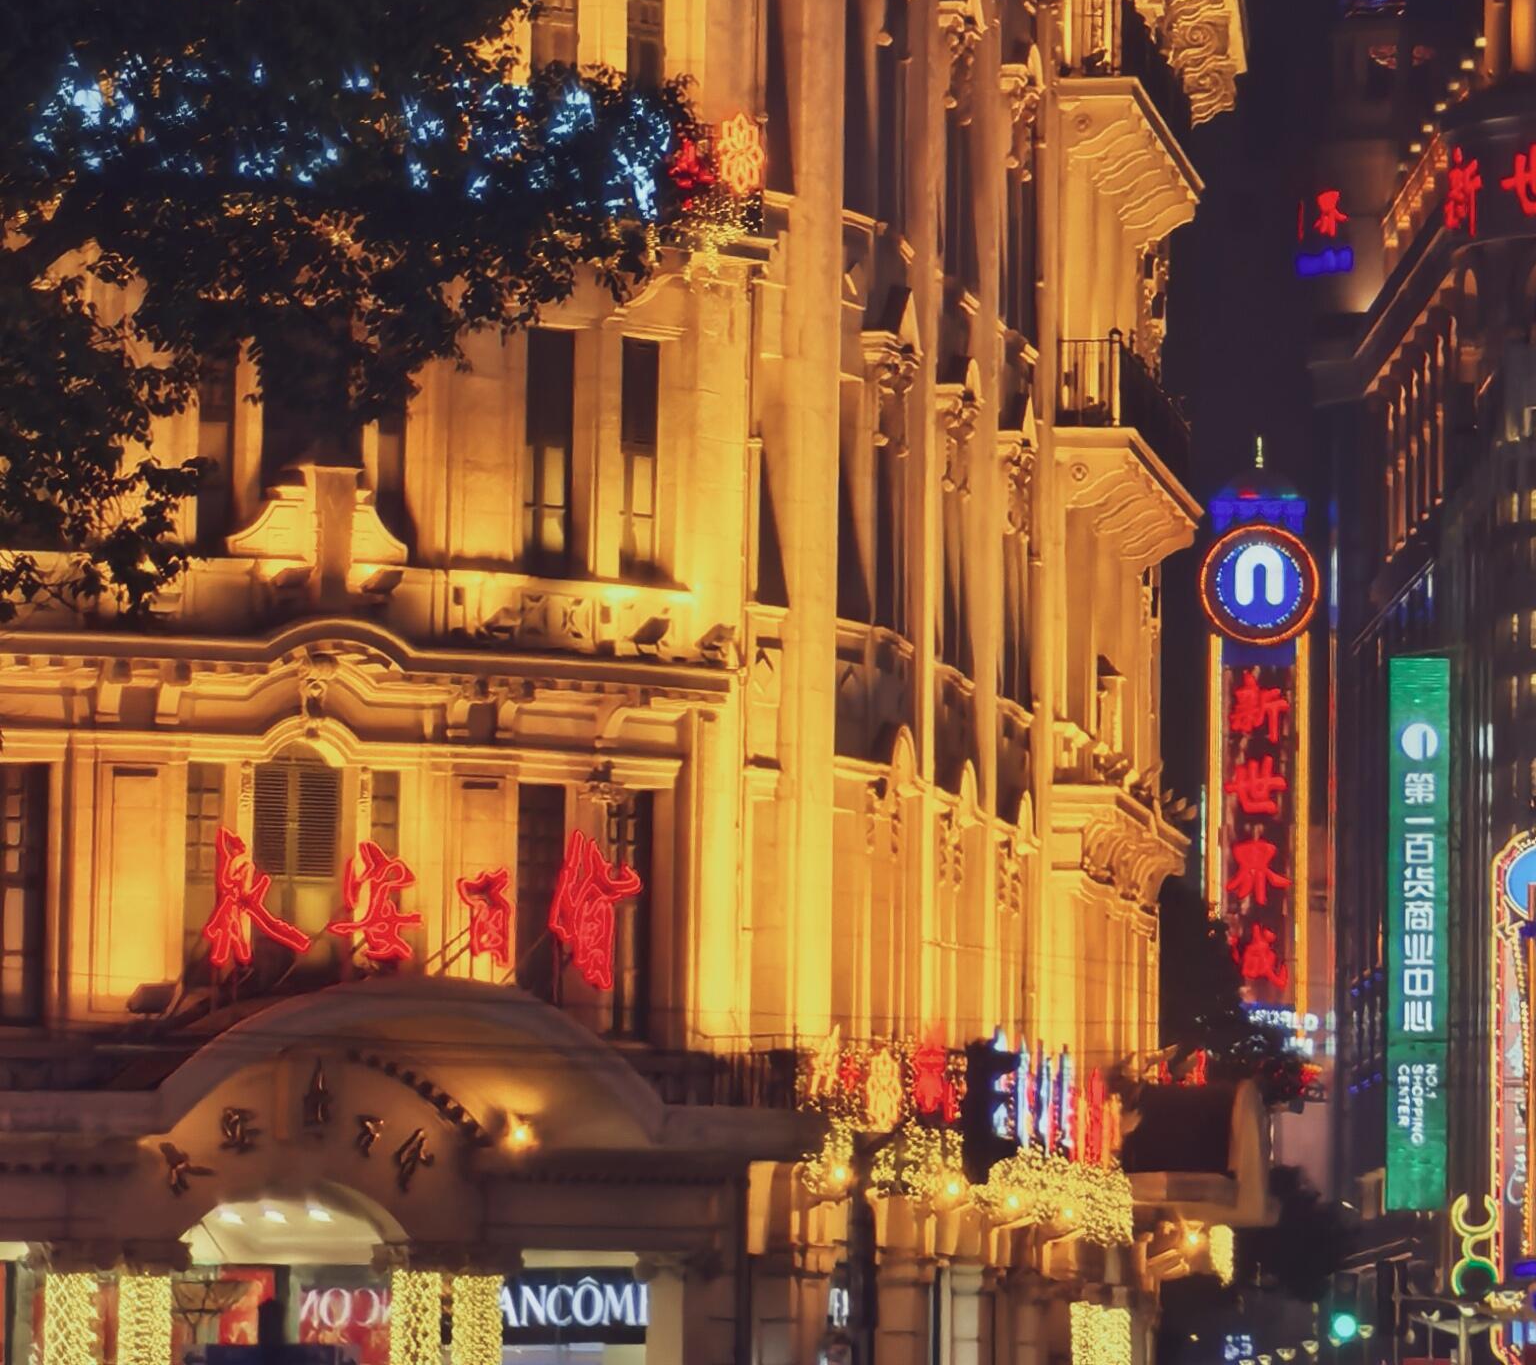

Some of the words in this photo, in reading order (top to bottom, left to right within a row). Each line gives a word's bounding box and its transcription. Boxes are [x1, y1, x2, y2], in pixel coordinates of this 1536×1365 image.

[1224, 670, 1291, 990] 新世界城
[1403, 772, 1435, 1033] 第一百货商业中心
[1398, 1063, 1410, 1128] CENTER
[1411, 1064, 1424, 1147] SHOPPING
[1425, 1064, 1438, 1099] NO.1
[499, 1275, 648, 1327] ANCÔM
